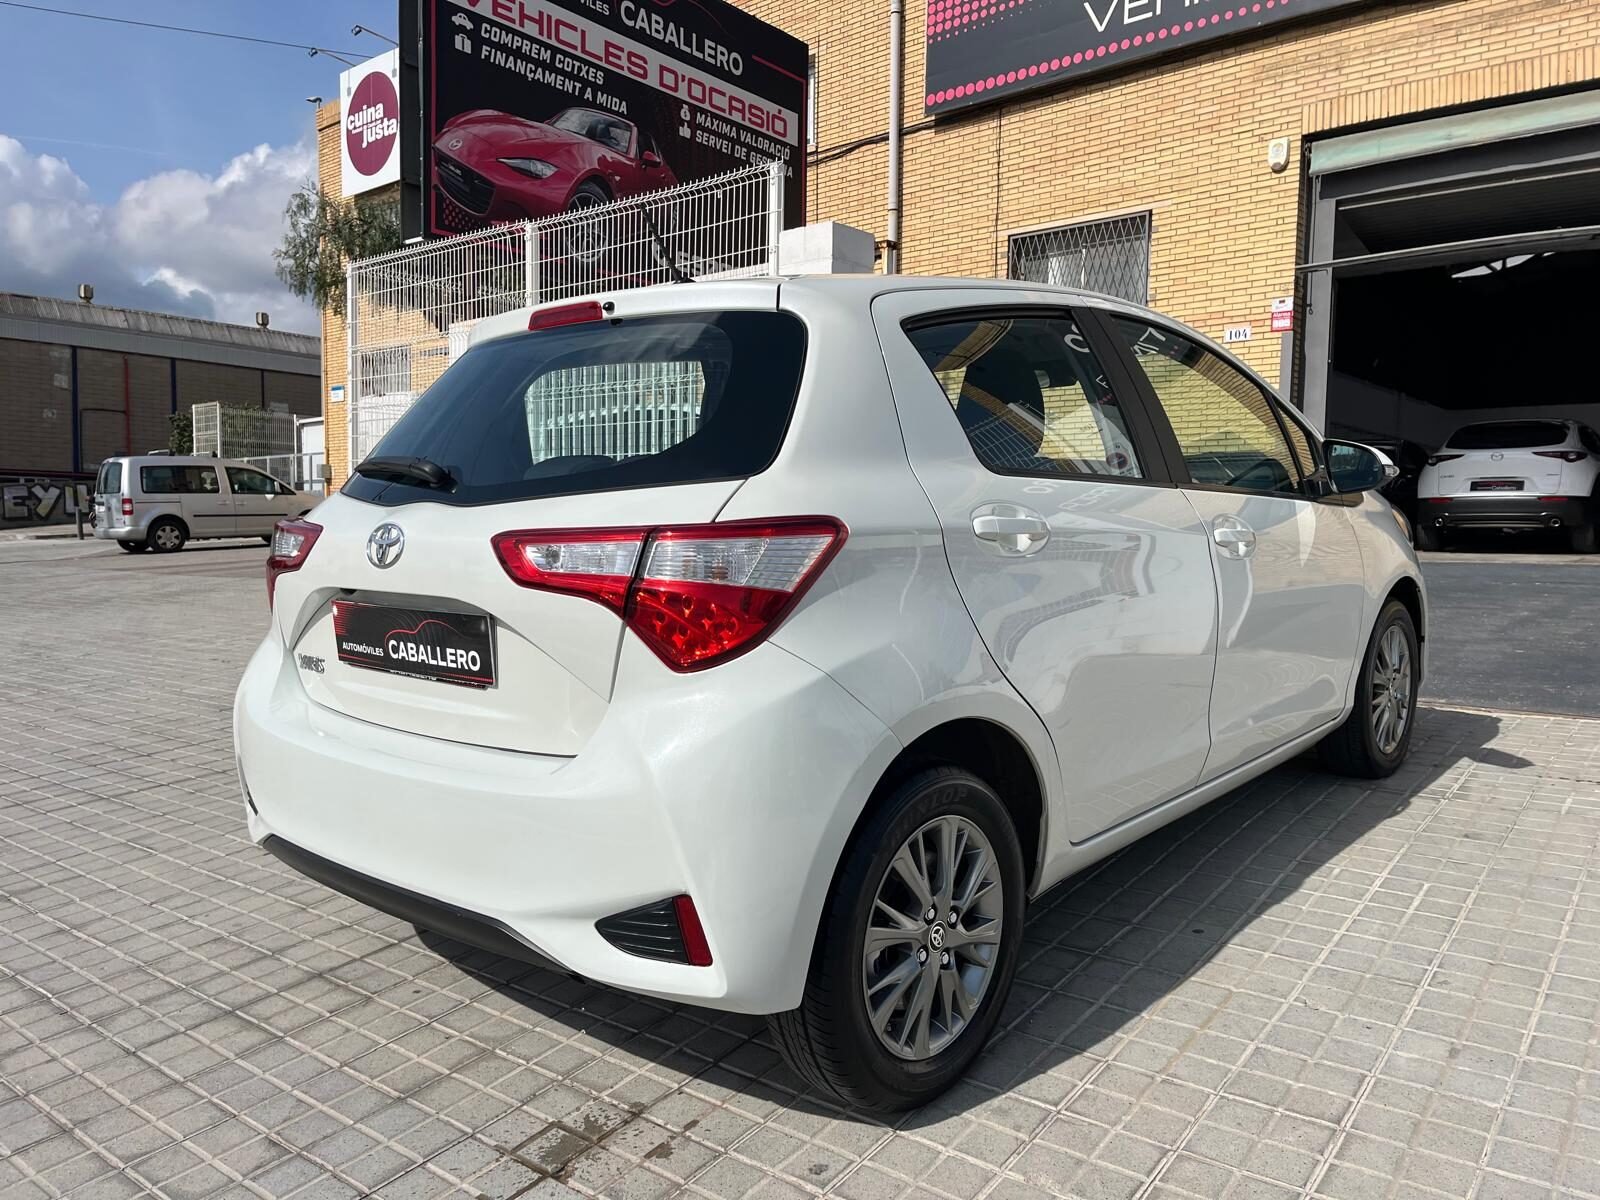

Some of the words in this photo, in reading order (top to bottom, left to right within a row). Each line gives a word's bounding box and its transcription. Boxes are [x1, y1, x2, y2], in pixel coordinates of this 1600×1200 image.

[480, 22, 552, 64] COMPREM
[555, 54, 605, 85] COTXES
[620, 0, 744, 76] CABALLERO
[480, 44, 582, 97] FINANÇAMENT
[584, 87, 593, 101] A
[596, 91, 628, 115] MIDA
[347, 102, 384, 130] cuina
[659, 63, 788, 139] D'OCASIÓ
[361, 117, 398, 149] justa
[695, 111, 738, 139] MÀXIMA
[739, 129, 791, 160] VALORACIÓ
[695, 130, 732, 154] SERVEI
[734, 144, 748, 160] DE
[1229, 328, 1248, 341] 104
[342, 640, 384, 657] AUTOMÓVILES
[388, 639, 481, 672] CABALLERO
